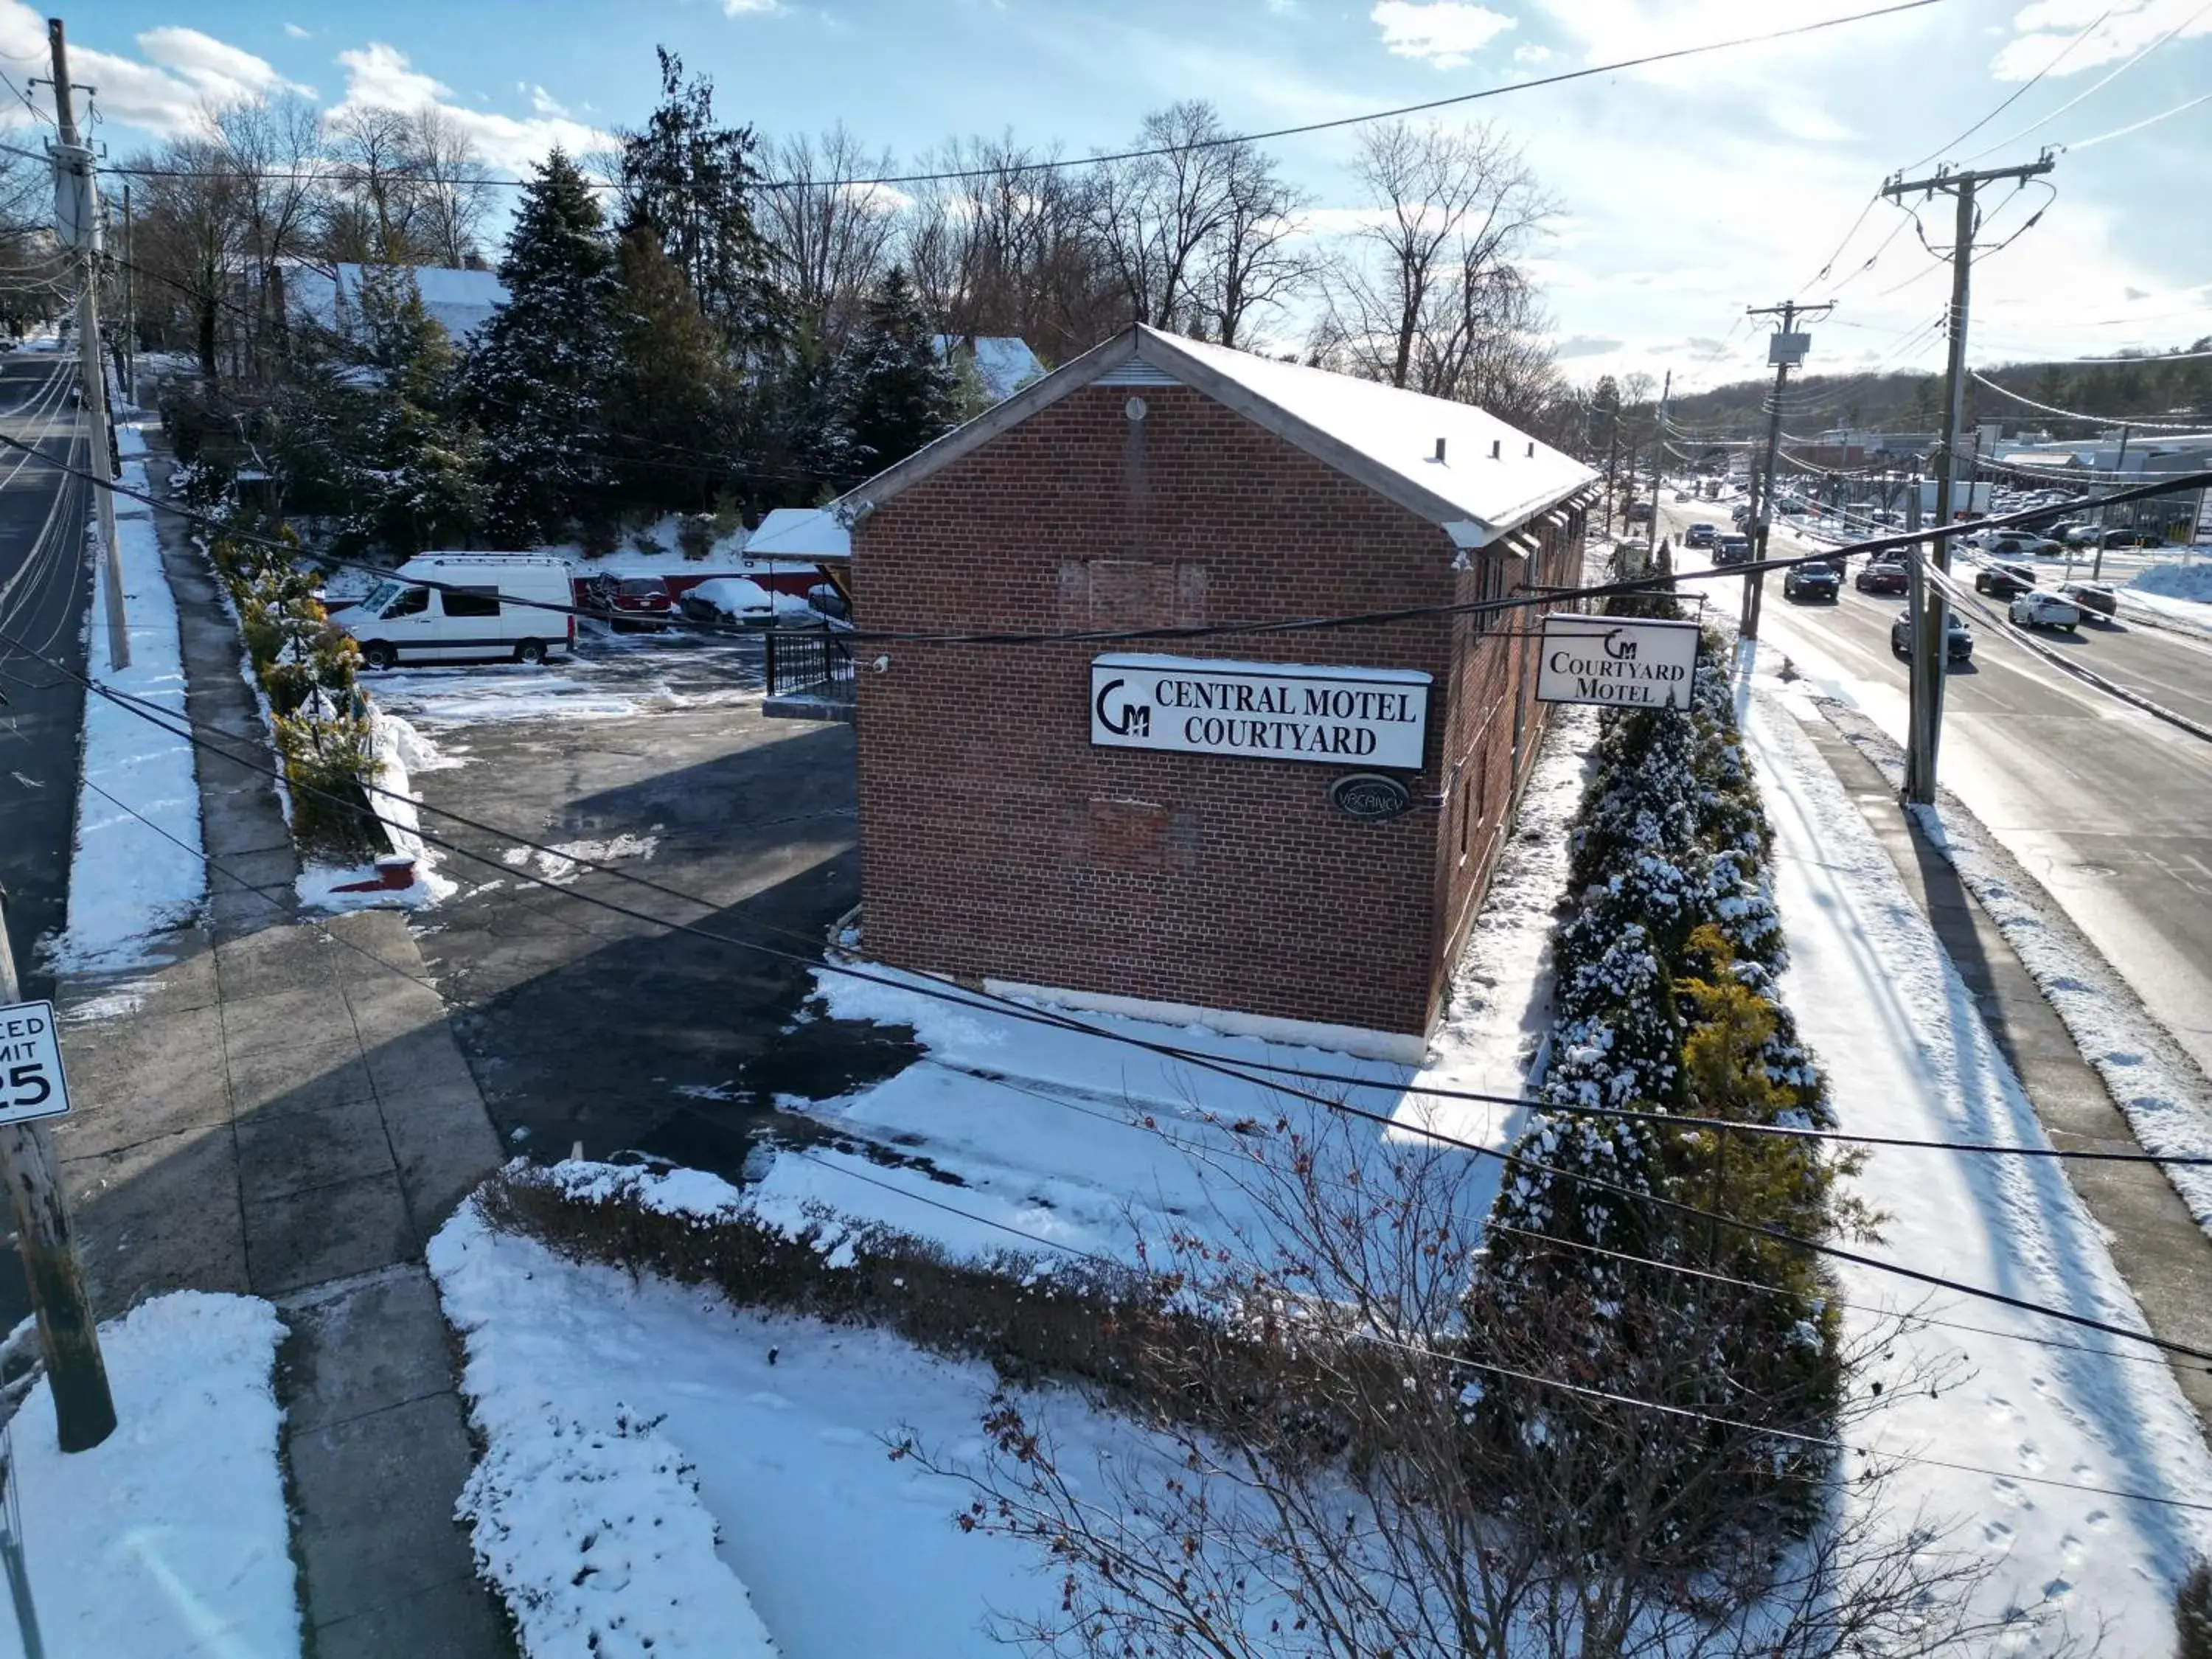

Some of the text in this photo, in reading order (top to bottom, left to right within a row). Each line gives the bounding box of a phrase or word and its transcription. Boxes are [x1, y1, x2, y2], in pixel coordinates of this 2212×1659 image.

[1550, 651, 1685, 681] COURTYARD
[1155, 679, 1416, 723] CENTRAL MOTEL
[1575, 678, 1656, 703] MOTEL
[1185, 716, 1377, 756] COURTYARD
[1338, 791, 1404, 812] VACANCY
